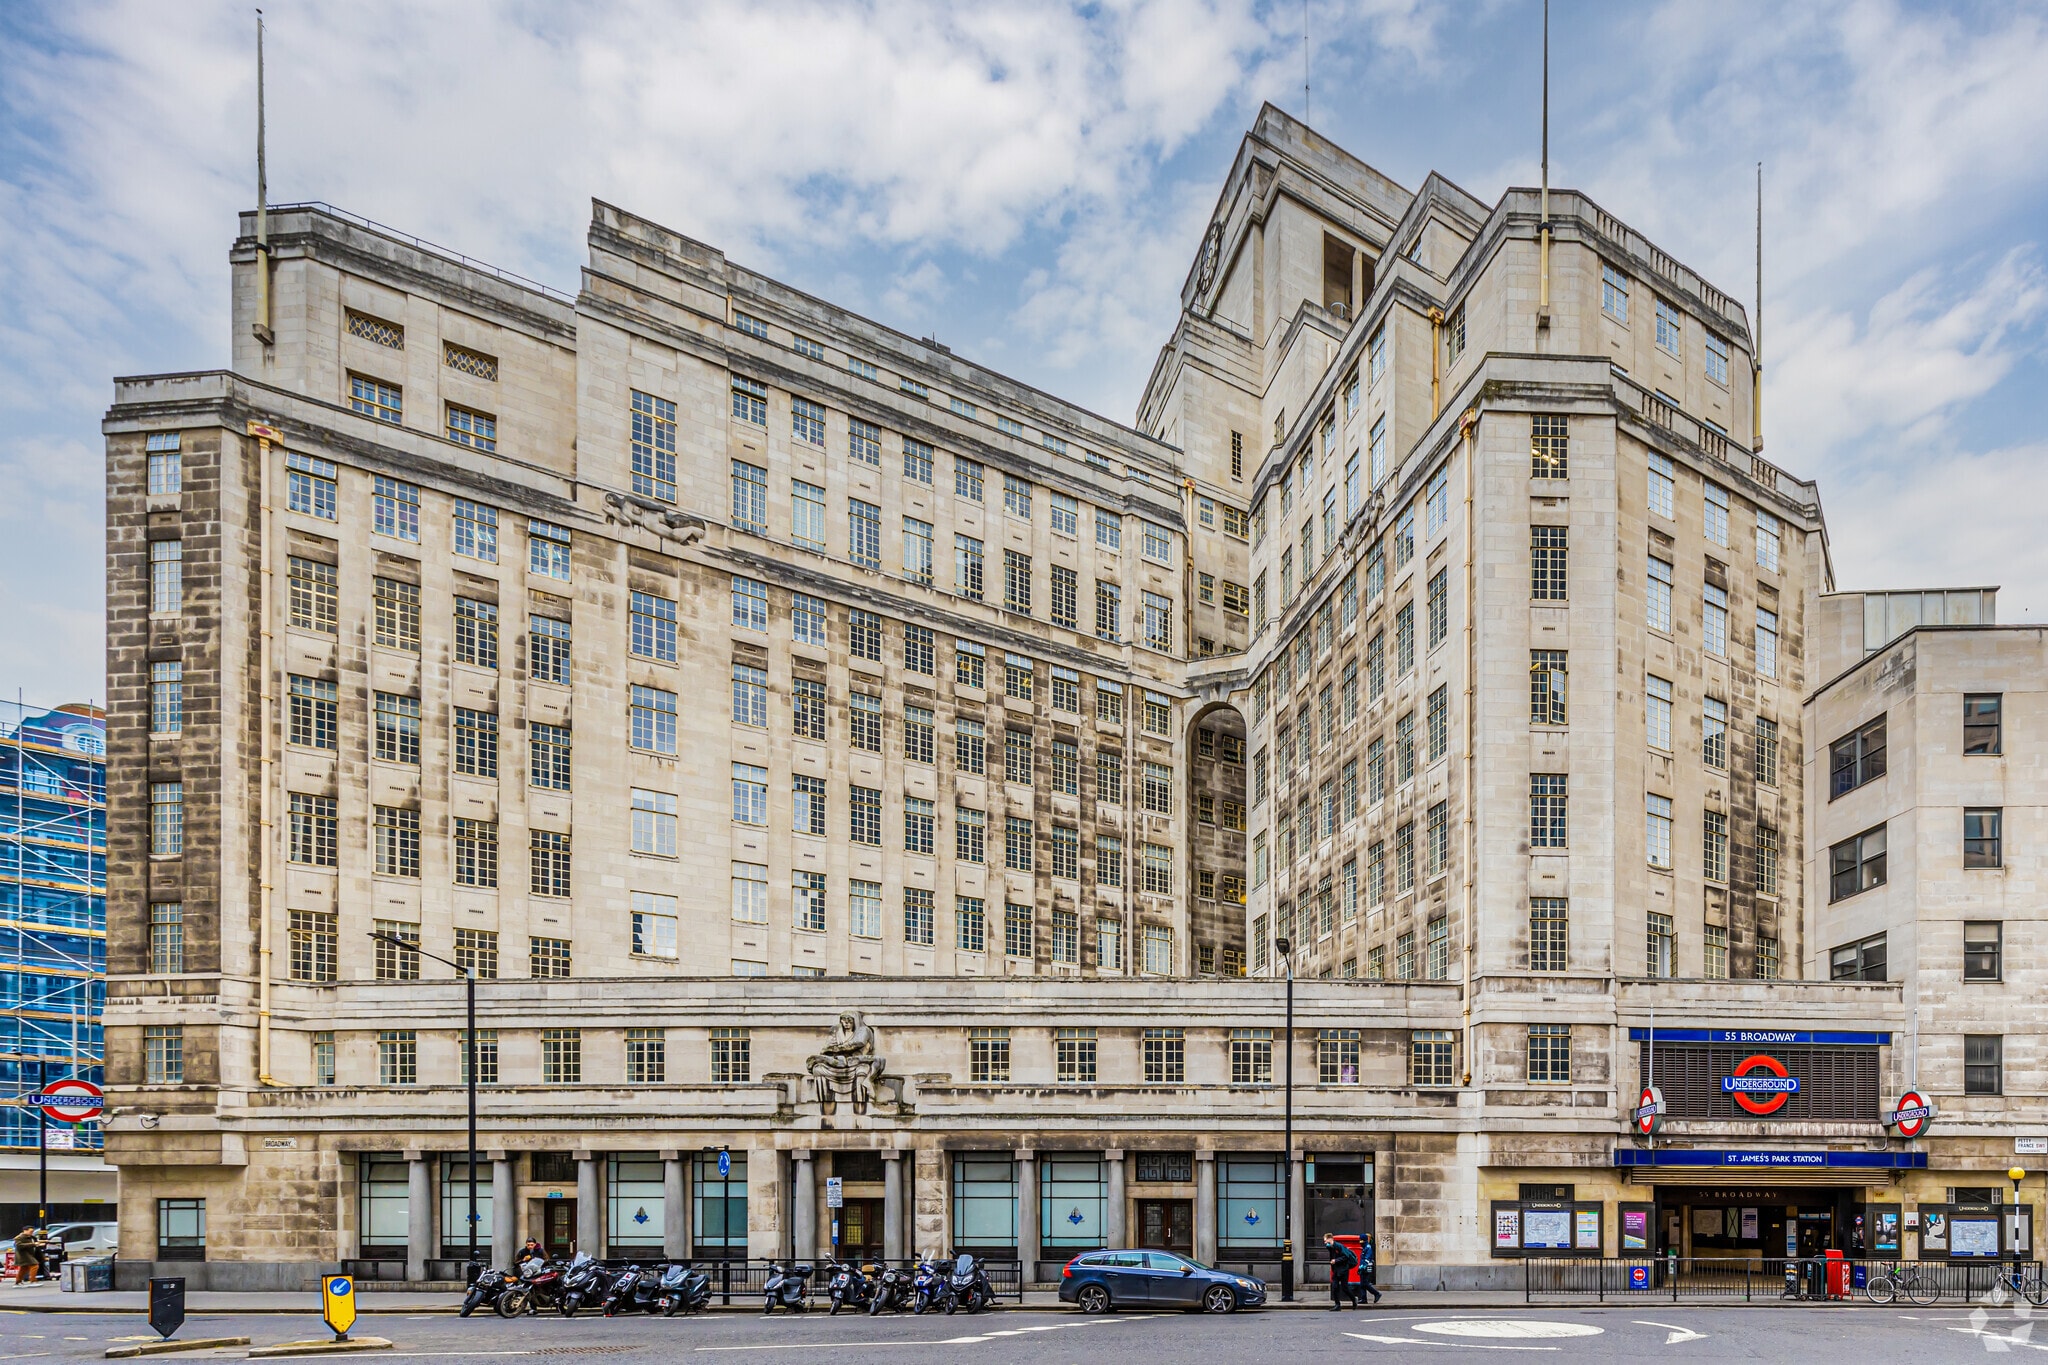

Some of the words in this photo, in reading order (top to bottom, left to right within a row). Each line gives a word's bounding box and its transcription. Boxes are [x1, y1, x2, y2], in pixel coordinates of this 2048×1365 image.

[1724, 1031, 1737, 1041] 55
[1740, 1032, 1796, 1042] BROADWAY
[1724, 1077, 1797, 1091] UNDERGROUND
[31, 1095, 103, 1107] UNDERGROUN
[1893, 1107, 1928, 1121] UNDERGROUND
[265, 1140, 291, 1148] BROADWAY
[1727, 1154, 1739, 1162] ST.
[1771, 1155, 1790, 1163] PARK
[1792, 1155, 1823, 1163] STATION
